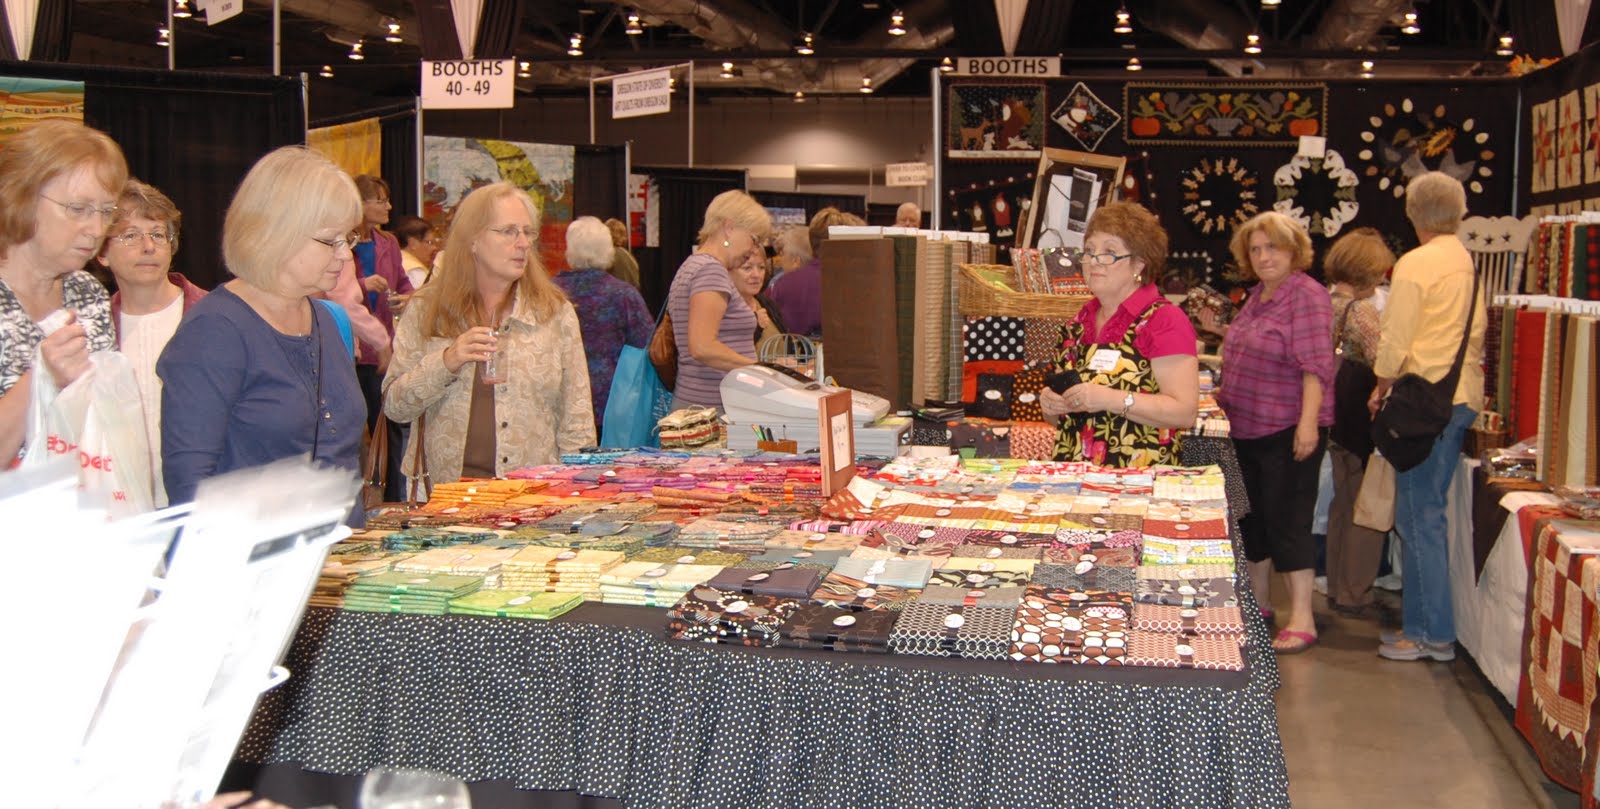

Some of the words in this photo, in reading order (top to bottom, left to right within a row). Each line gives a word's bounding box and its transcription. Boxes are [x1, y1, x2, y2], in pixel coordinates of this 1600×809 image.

[432, 61, 503, 76] BOOTHS
[968, 59, 1048, 74] BOOTHS
[446, 80, 462, 96] 40
[474, 80, 490, 96] 49
